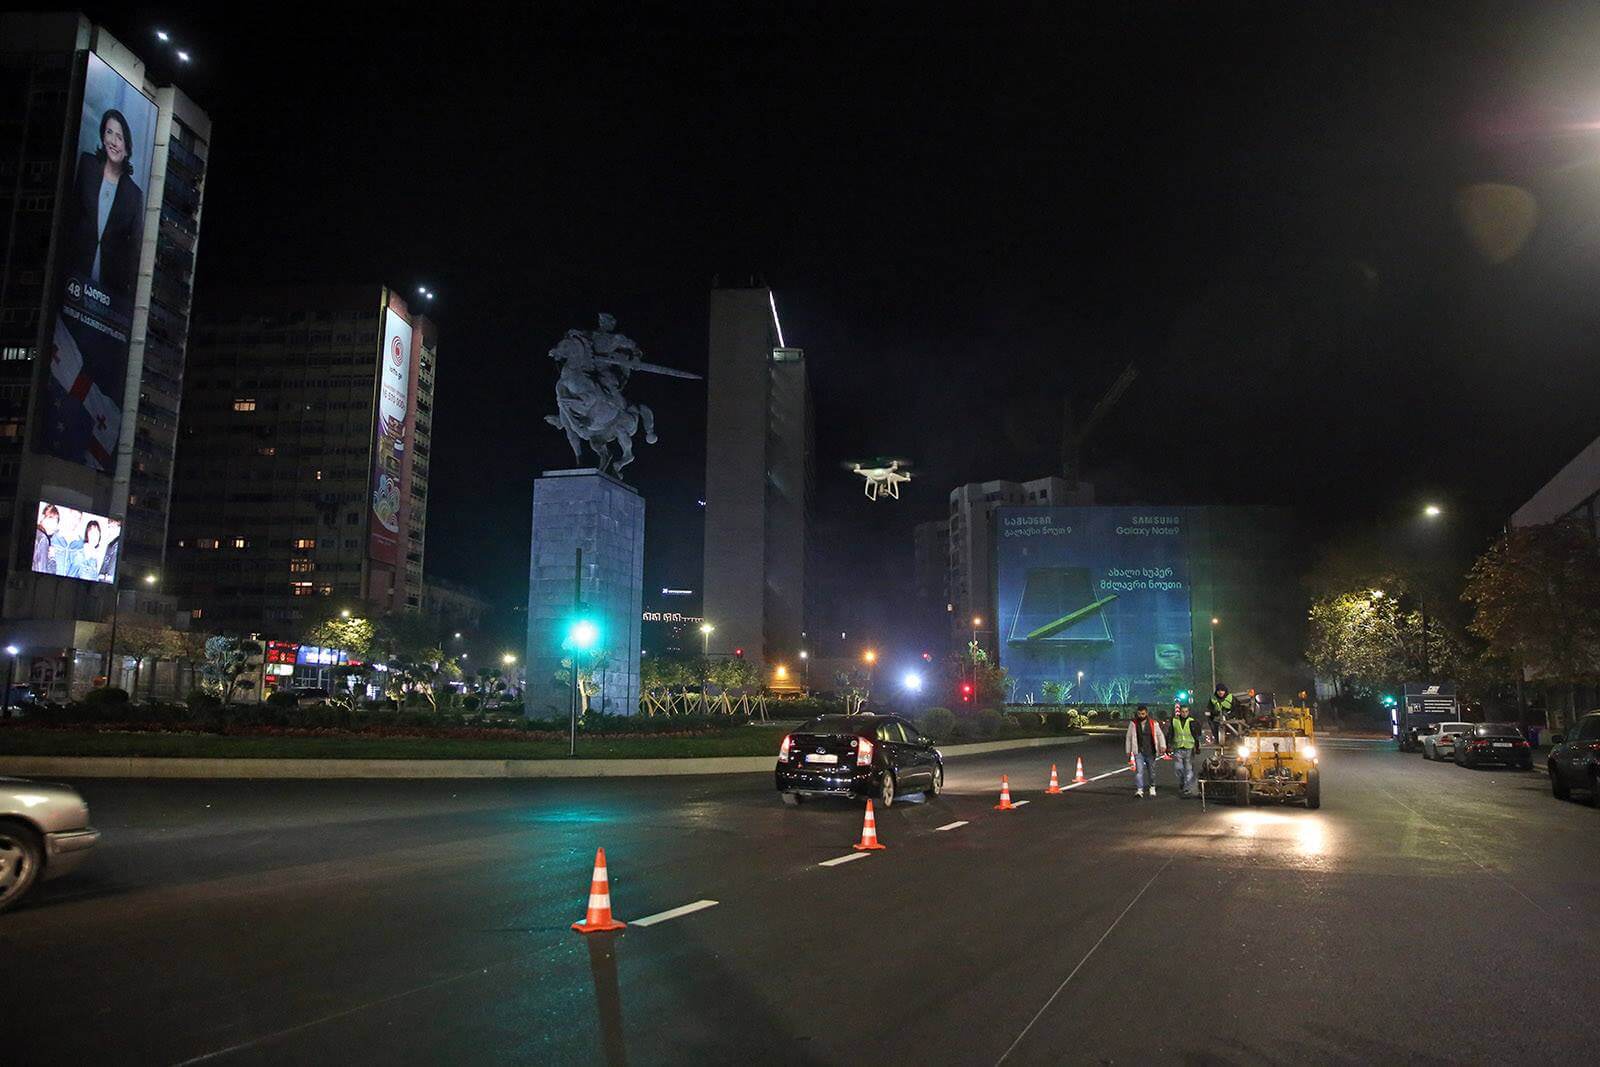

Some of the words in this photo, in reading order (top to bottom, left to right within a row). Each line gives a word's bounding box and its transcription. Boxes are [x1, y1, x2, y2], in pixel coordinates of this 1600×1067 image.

[67, 282, 81, 298] 48
[1132, 516, 1180, 525] SAMSUNG
[1066, 526, 1072, 534] 9
[1116, 526, 1151, 537] Galaxy
[1108, 567, 1141, 578] ახალი
[1142, 567, 1174, 578] სუპერ
[1100, 579, 1147, 592] მძლავრი
[1148, 579, 1183, 591] ნოუთი
